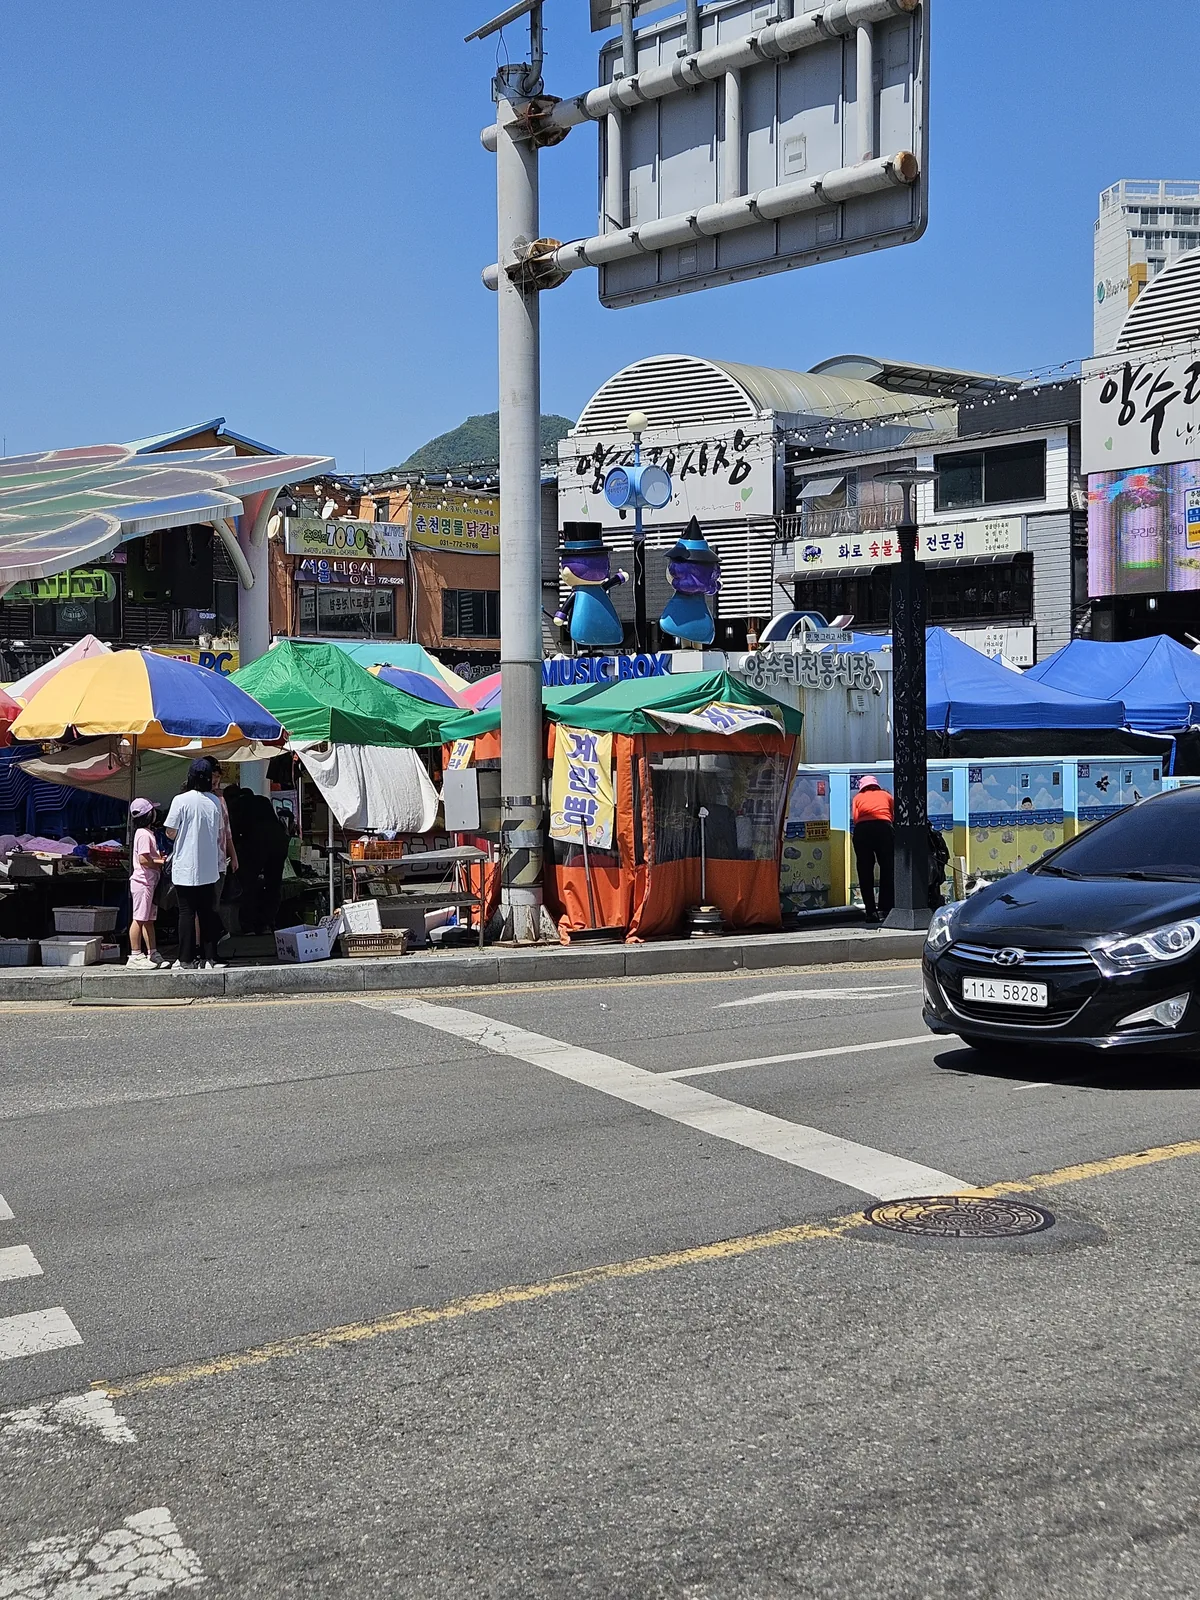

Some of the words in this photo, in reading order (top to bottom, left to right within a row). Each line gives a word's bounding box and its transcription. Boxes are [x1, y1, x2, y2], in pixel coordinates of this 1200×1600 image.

[837, 543, 863, 560] 화로
[926, 531, 965, 553] 전문점
[300, 559, 331, 584] 서울
[333, 560, 376, 586] 미용실
[820, 632, 836, 641] 그리고
[199, 652, 234, 678] PC
[542, 656, 611, 687] MUSIC
[618, 653, 668, 681] BOX
[744, 651, 876, 688] 양수리전통시장
[563, 732, 601, 828] 계란빵
[971, 981, 996, 998] 11소
[1003, 984, 1039, 1003] 5828
